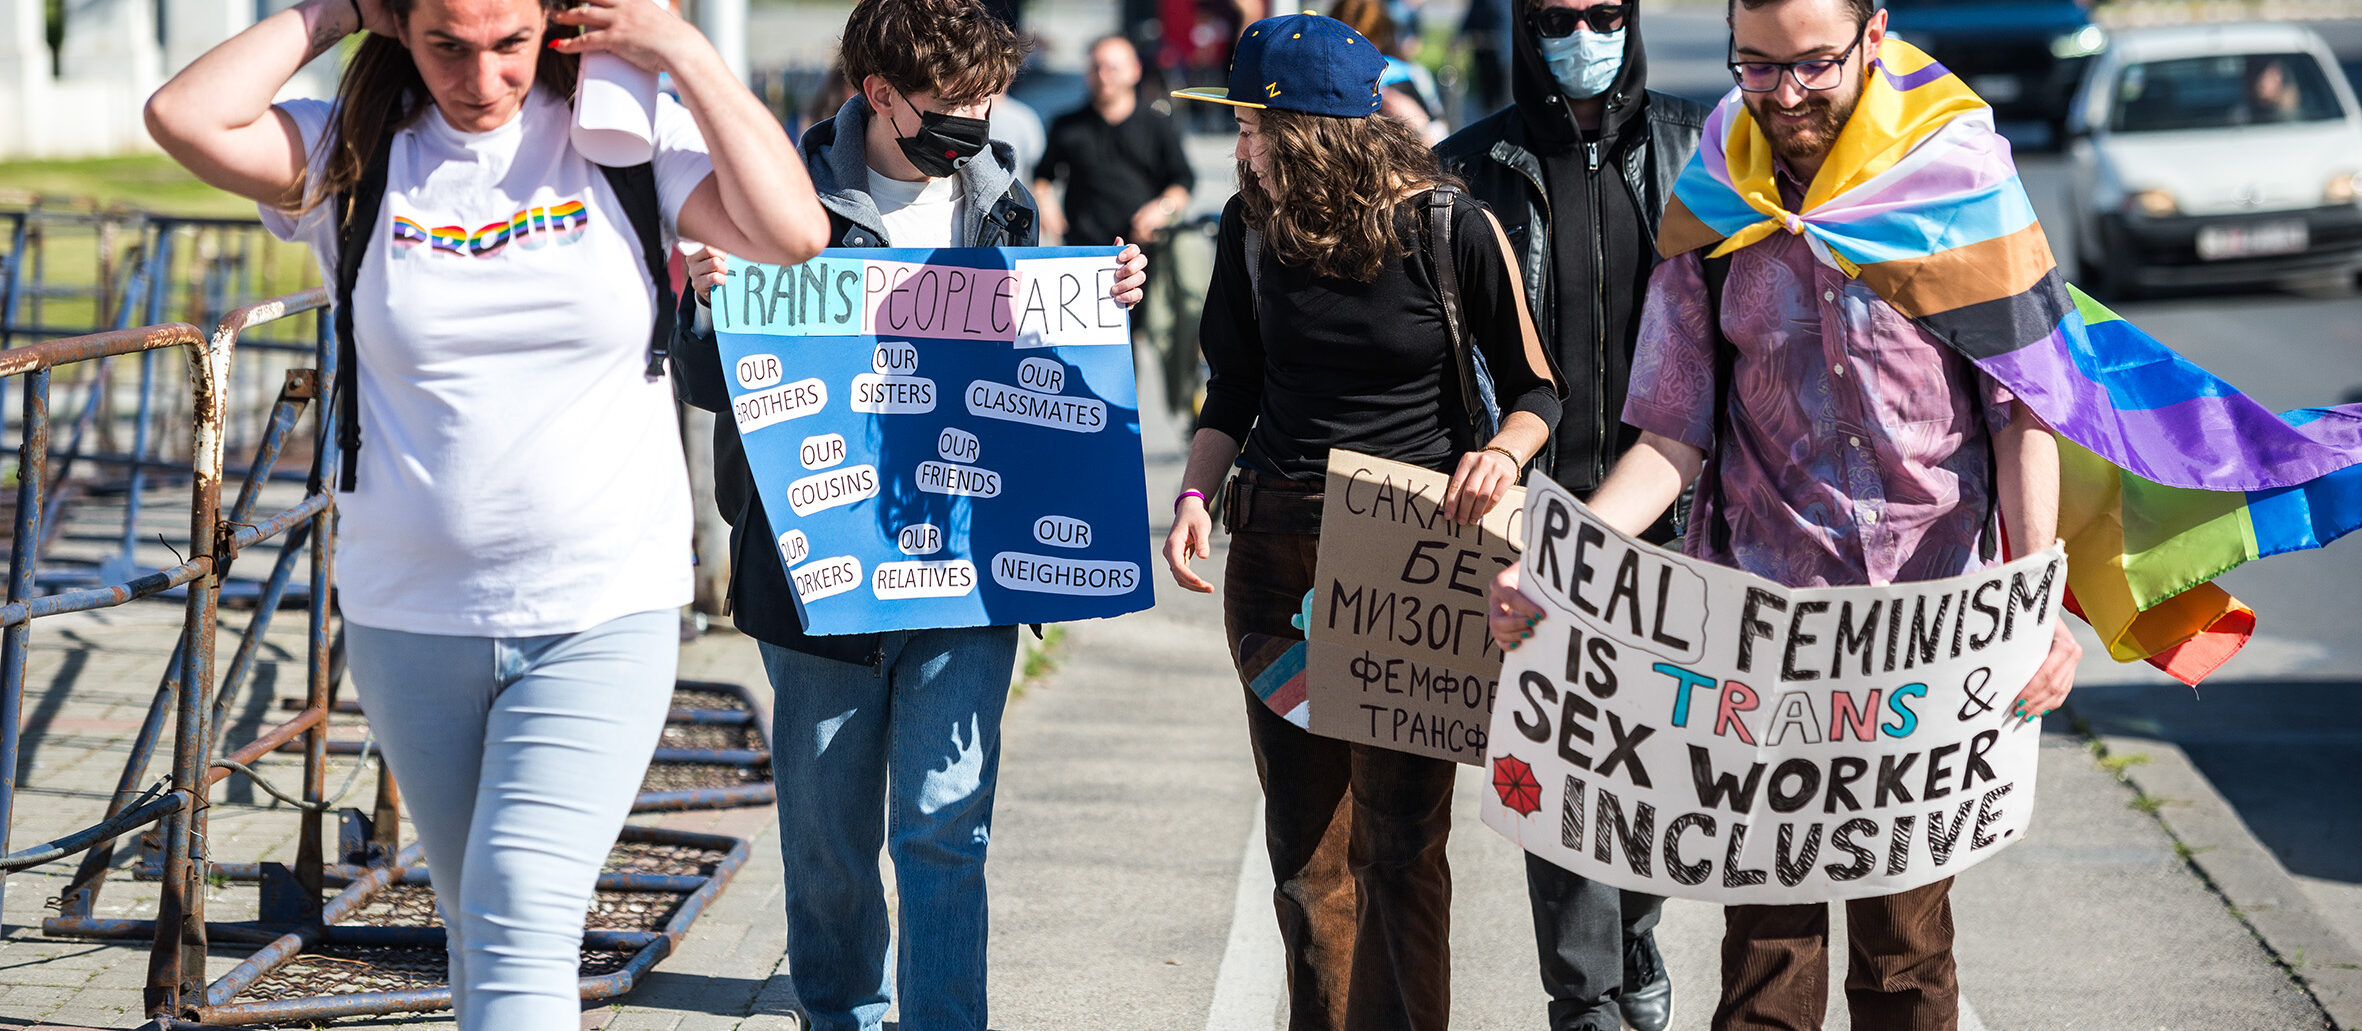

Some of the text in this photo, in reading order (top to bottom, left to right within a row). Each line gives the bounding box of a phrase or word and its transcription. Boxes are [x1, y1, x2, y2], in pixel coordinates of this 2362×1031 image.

[391, 200, 588, 260] PROUD
[721, 262, 1123, 336] TRANS PEOPLE ARE
[740, 358, 779, 383] OUR
[876, 348, 916, 370] OUR
[859, 382, 932, 405] SISTERS
[1020, 363, 1062, 392] OUR
[735, 384, 819, 424] BROTHERS
[972, 386, 1102, 427] CLASSMATES
[801, 439, 845, 467] OUR
[939, 432, 979, 461] OUR
[791, 469, 874, 506] COUSINS
[921, 463, 997, 495] FRIENDS
[901, 528, 939, 550] OUR
[1037, 519, 1090, 546] OUR
[780, 536, 807, 563] OUR
[793, 562, 854, 596] ORKERS
[877, 566, 972, 590] RELATIVES
[999, 556, 1135, 589] NEIGHBORS
[1536, 496, 2058, 683] REAL FEMINISM
[1565, 625, 1999, 747] IS TRANS &
[1512, 670, 2000, 815] SEX WORKER
[1560, 773, 2016, 889] INCLUSIVE.
